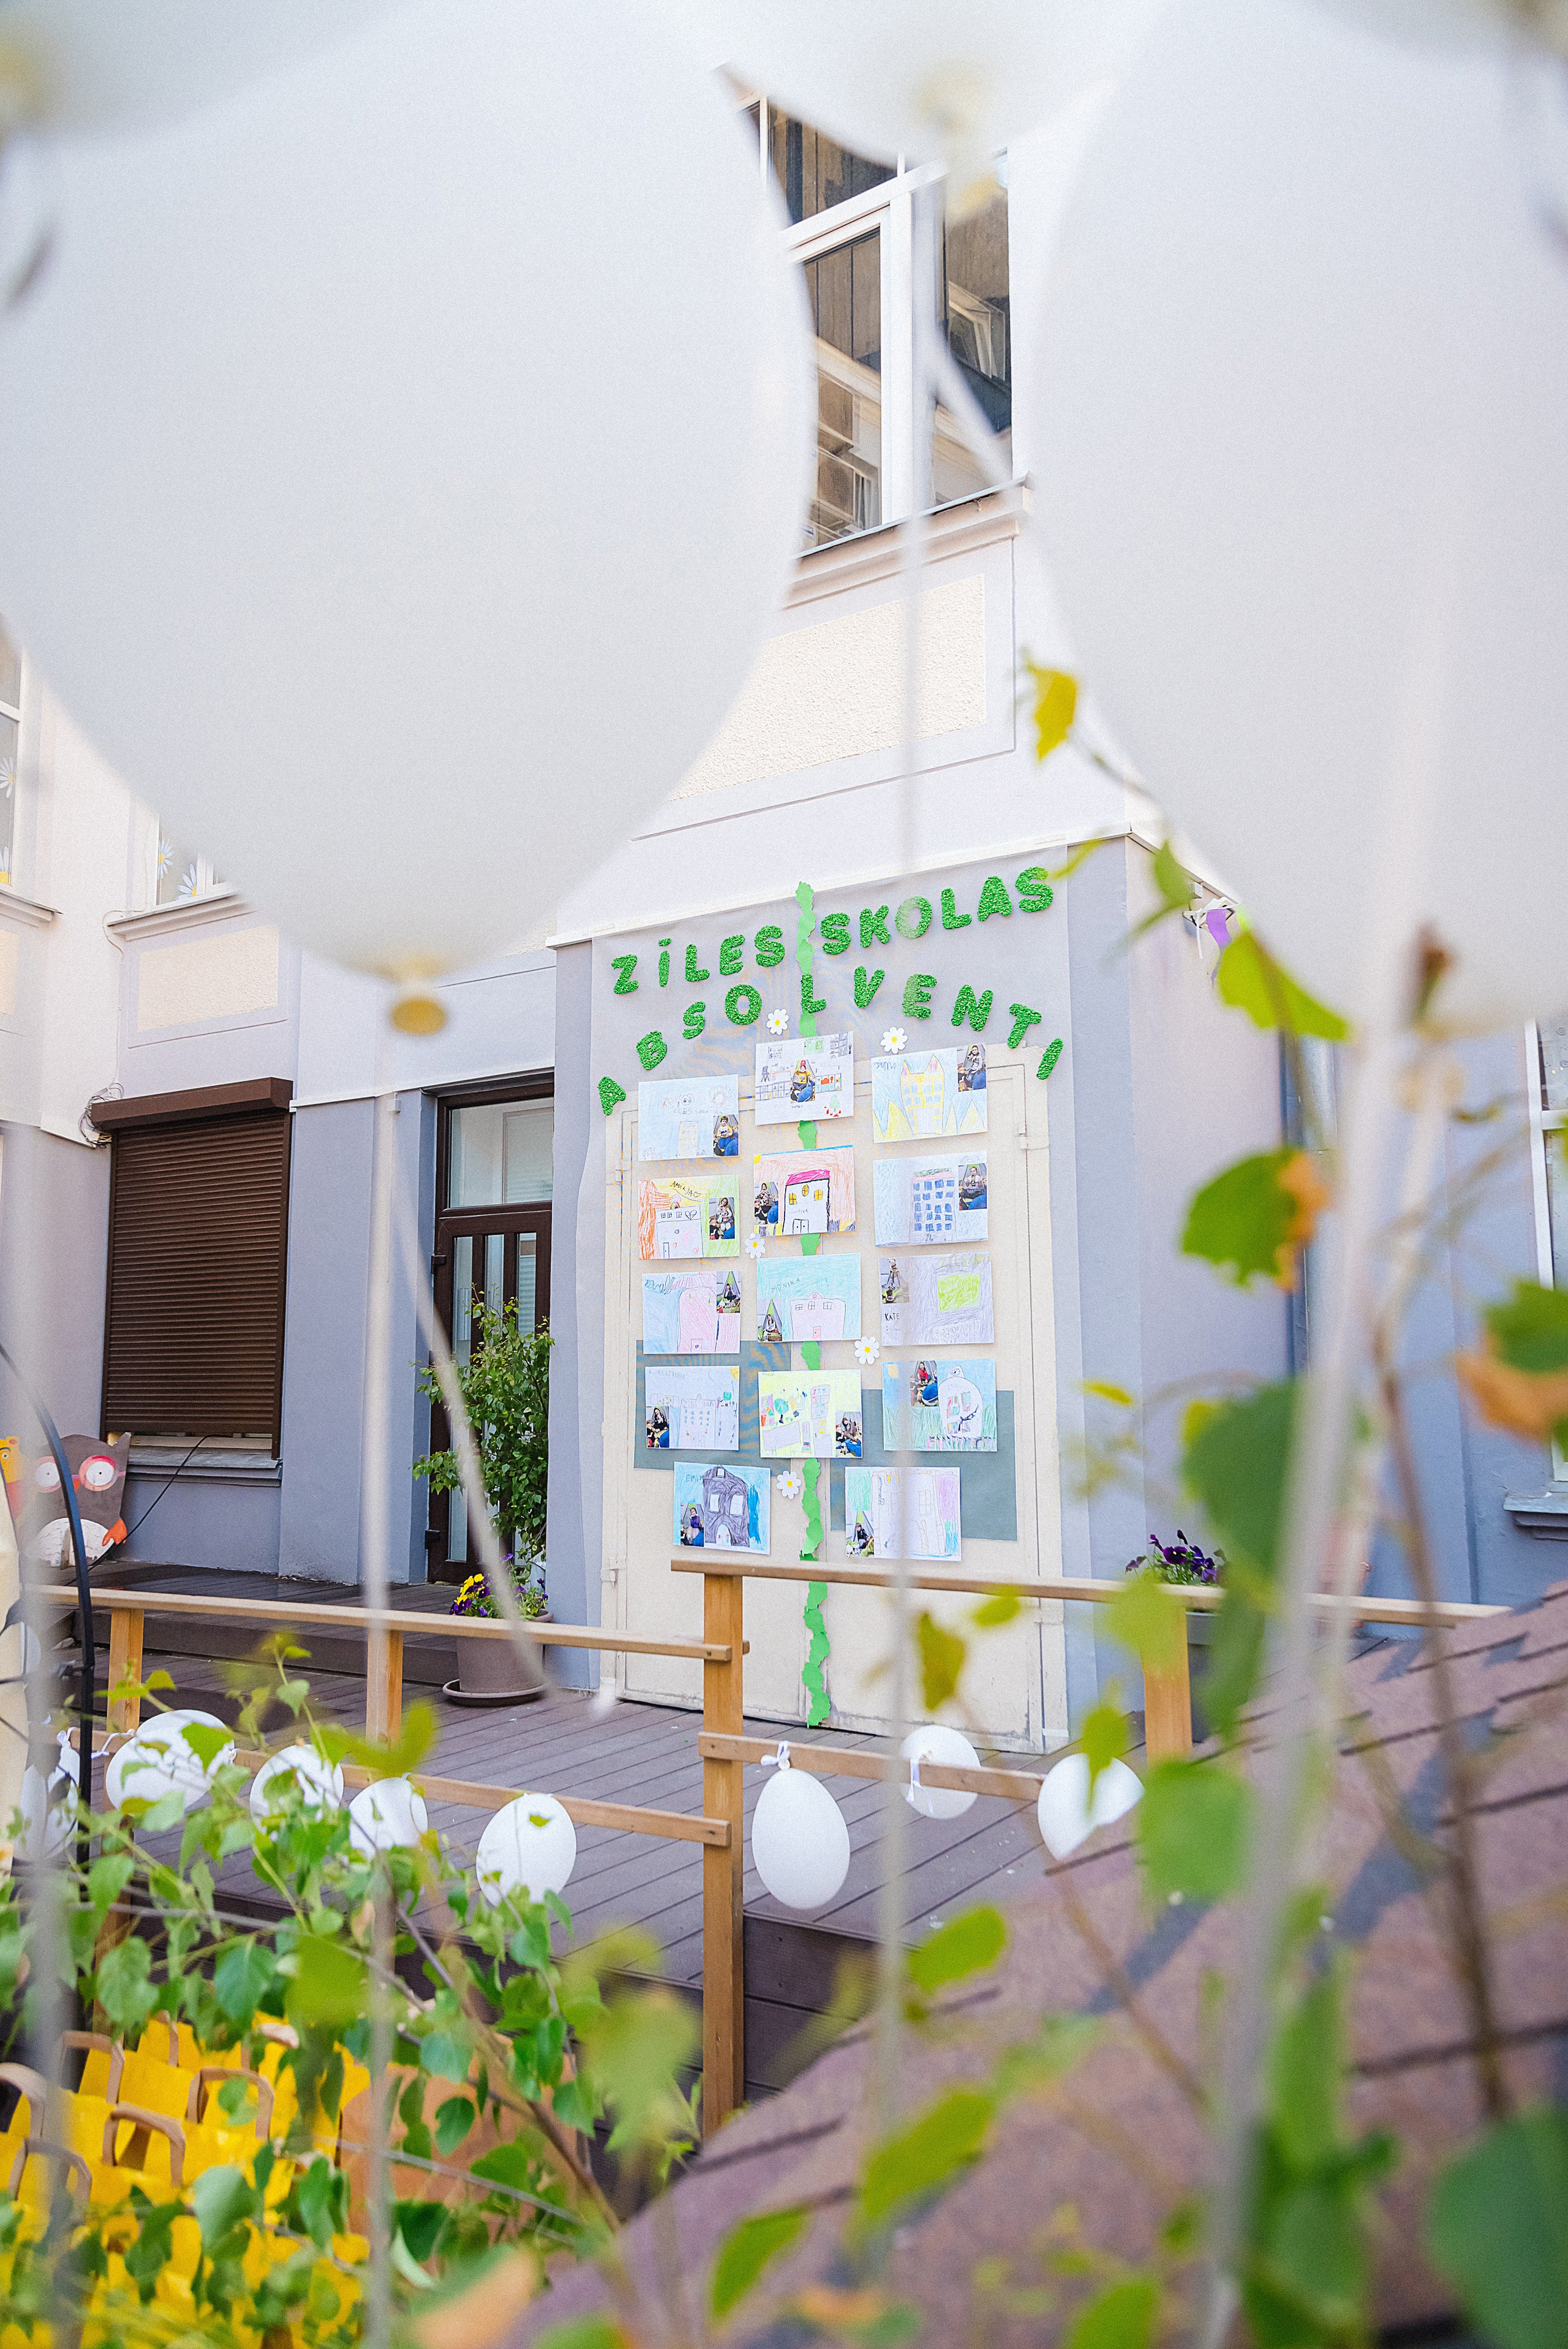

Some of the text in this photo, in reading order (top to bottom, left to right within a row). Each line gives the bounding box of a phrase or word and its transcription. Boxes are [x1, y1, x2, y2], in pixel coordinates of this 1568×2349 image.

[820, 866, 1054, 956] SKOLAS
[597, 966, 1065, 1116] ABSOLVENTI
[885, 1313, 900, 1321] KATE
